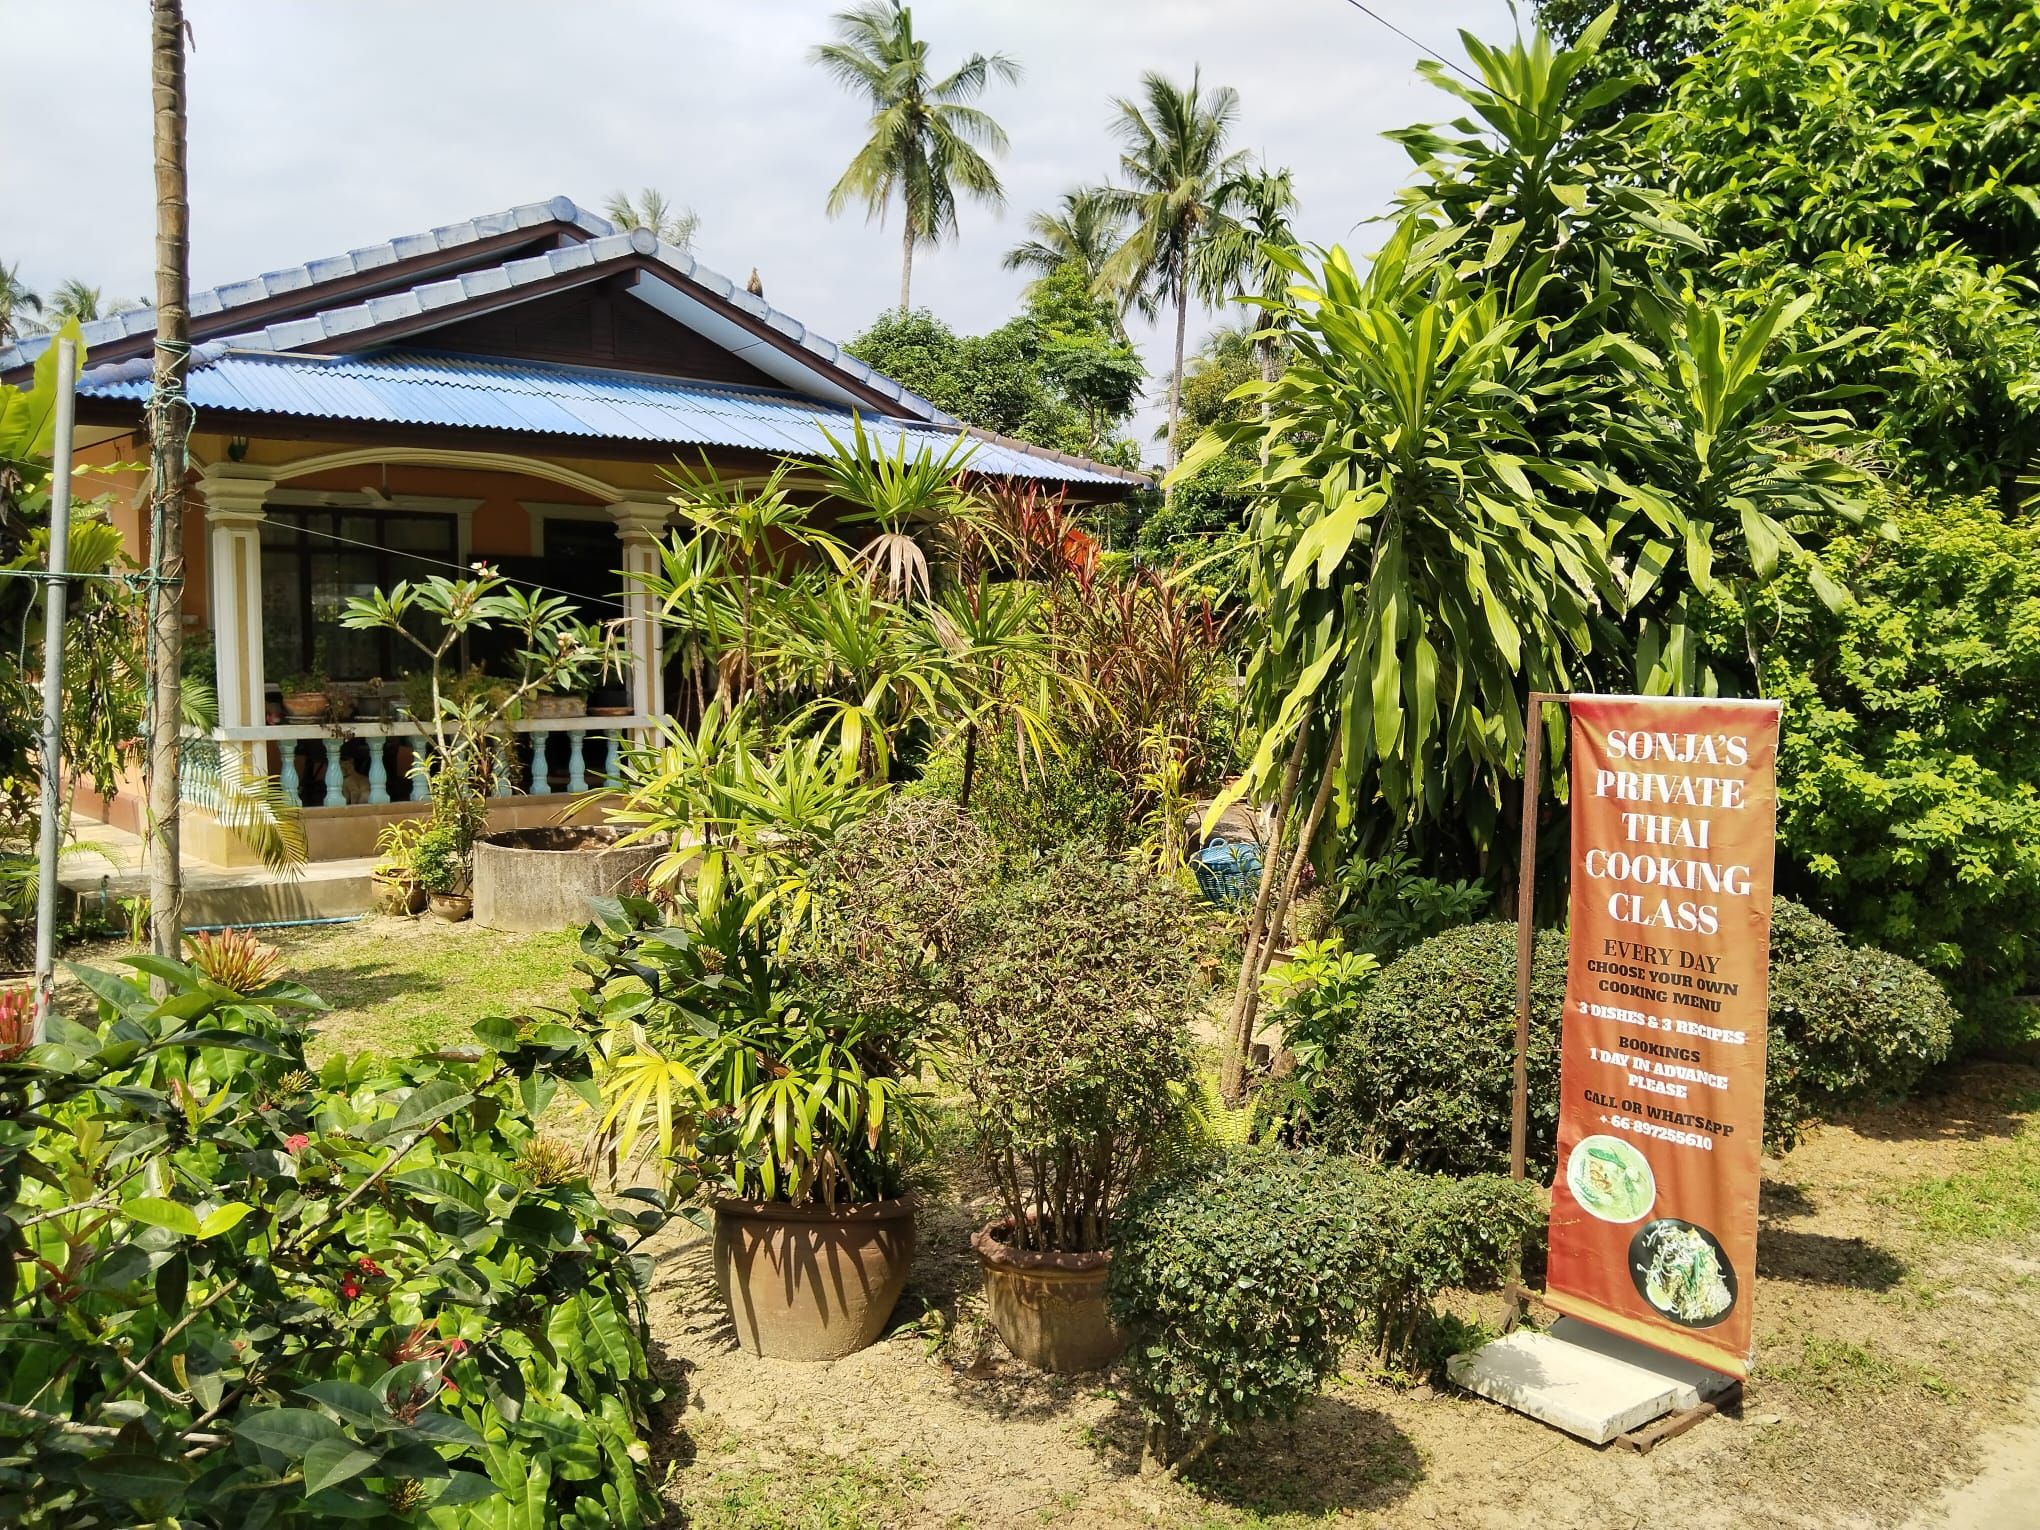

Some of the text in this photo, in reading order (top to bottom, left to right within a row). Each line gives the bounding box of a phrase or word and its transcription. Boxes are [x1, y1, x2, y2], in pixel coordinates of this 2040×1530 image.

[1606, 730, 1748, 766] SONJA'S
[1595, 769, 1744, 808] PRIVATE
[1622, 812, 1710, 849] THAI
[1586, 849, 1752, 895] COOKING
[1608, 892, 1718, 935] CLASS
[1604, 939, 1720, 974] EVERY DAY
[1588, 960, 1738, 996] CHOOSE YOUR OWN
[1599, 980, 1721, 1012] COOKING MENU
[1579, 1002, 1745, 1044] 3 DISHES & 3 RECIPES
[1619, 1036, 1700, 1063] BOOKINGS
[1590, 1048, 1728, 1090] 1 DAY IN ADVANCE
[1628, 1074, 1687, 1098] PLEASE
[1584, 1090, 1734, 1137] CALL OR WHATSAPP
